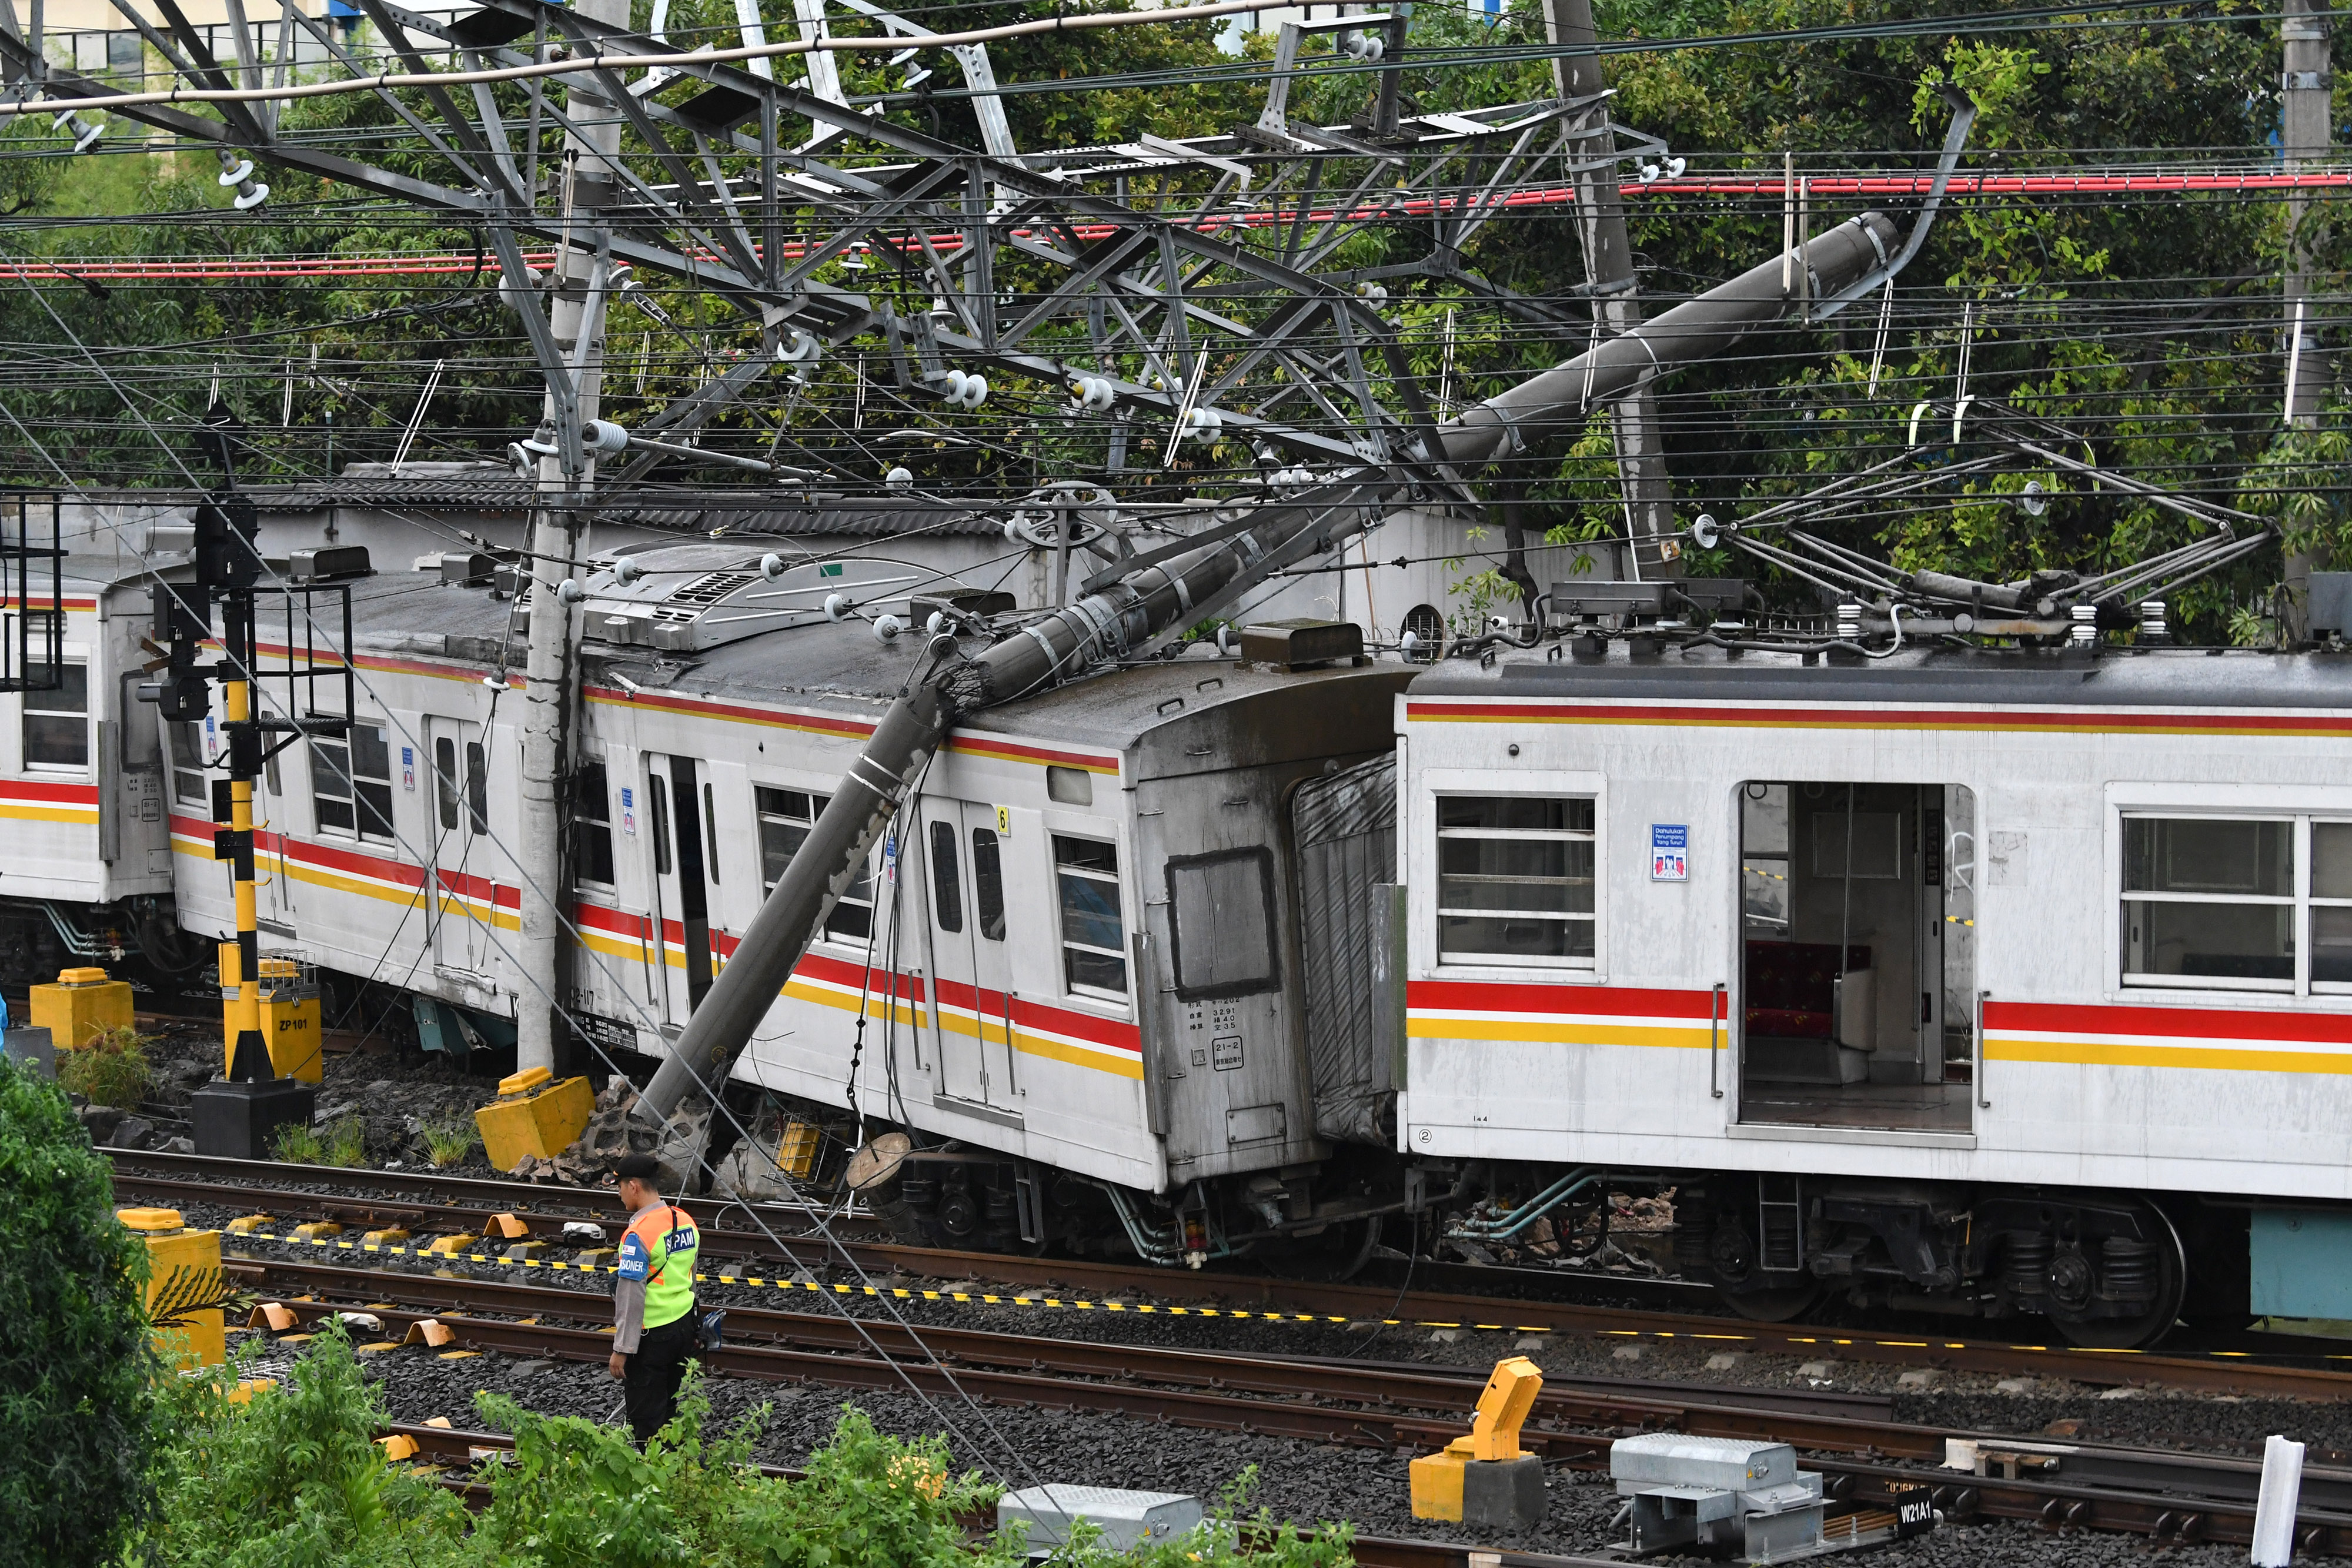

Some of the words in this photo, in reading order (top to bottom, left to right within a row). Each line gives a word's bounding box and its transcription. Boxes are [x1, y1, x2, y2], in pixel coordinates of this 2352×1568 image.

[1000, 810, 1005, 829] 6
[280, 1020, 291, 1031] ZP
[293, 1018, 307, 1030] 101
[1216, 1042, 1238, 1051] 21-2
[667, 1231, 694, 1252] SPAM
[1900, 1500, 1930, 1523] W21A1
